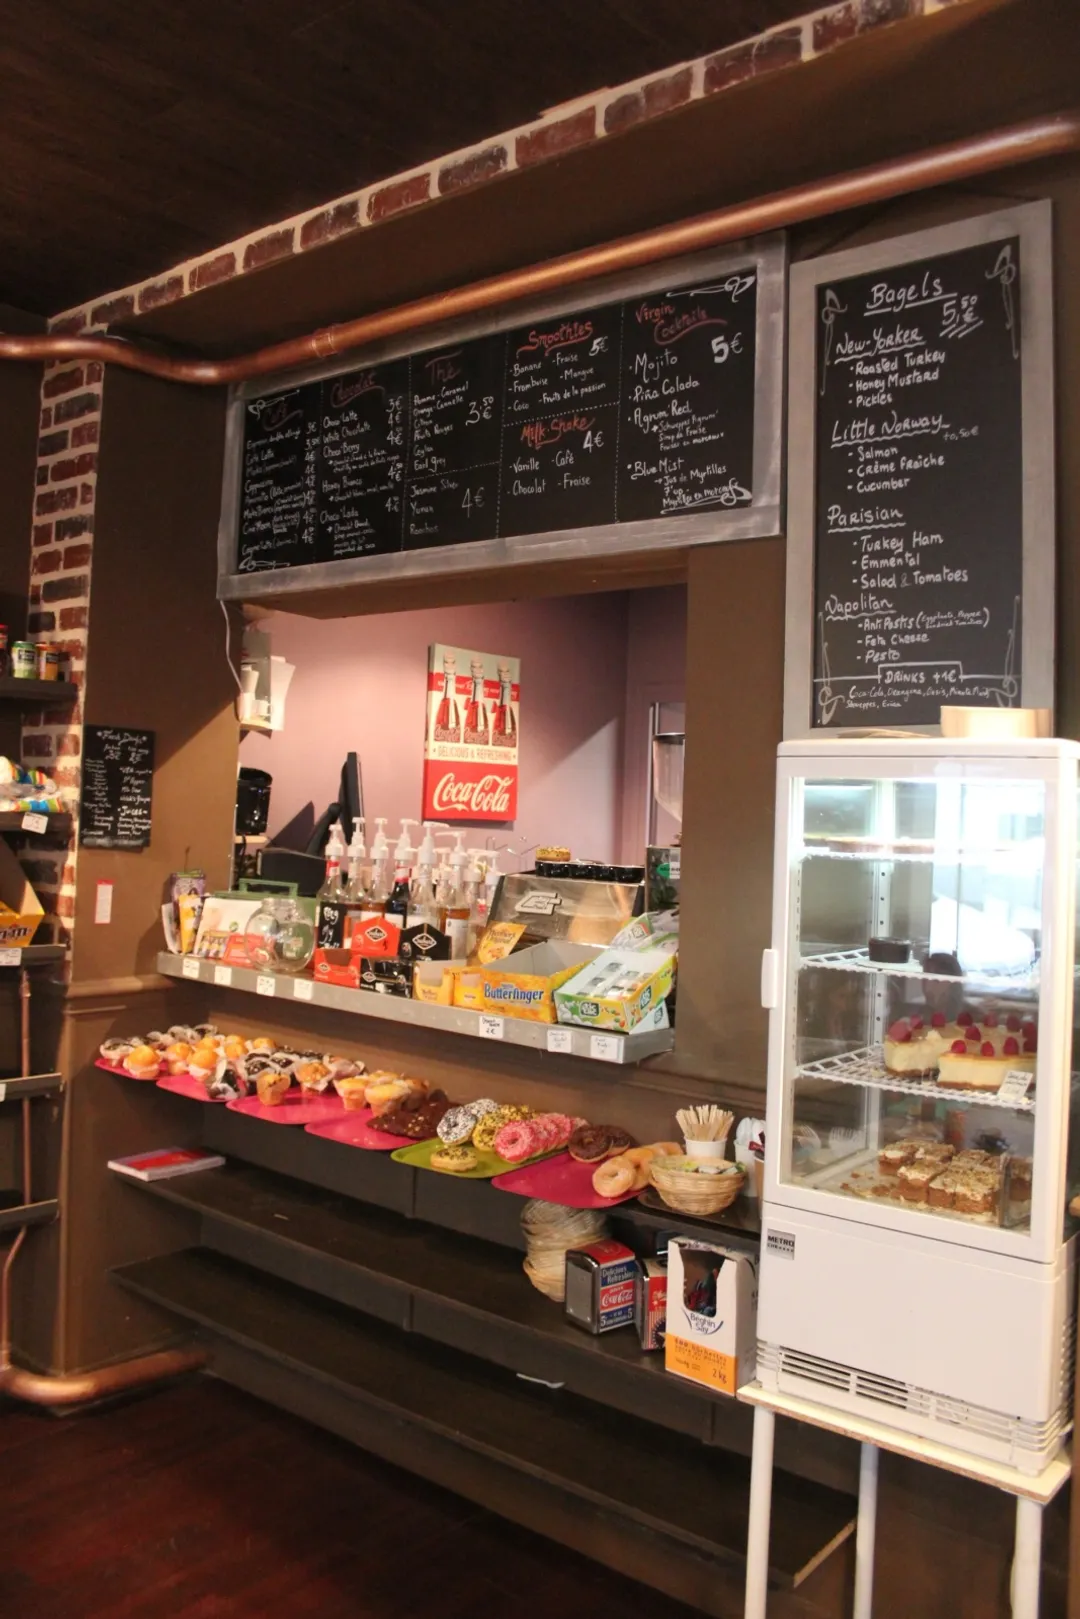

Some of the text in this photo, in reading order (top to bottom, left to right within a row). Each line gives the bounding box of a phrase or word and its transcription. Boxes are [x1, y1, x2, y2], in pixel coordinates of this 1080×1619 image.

[866, 271, 943, 312] Bagels
[635, 302, 676, 323] Virgin
[513, 352, 578, 377] Banane Fraise
[635, 348, 679, 384] Mojito
[855, 350, 946, 376] Roasted Turkey
[513, 367, 594, 393] Framboise Mangue
[633, 375, 700, 403] Piña Colada
[855, 369, 940, 393] Honey Mustard
[513, 382, 606, 412] Coco Fruits de la passion
[855, 394, 893, 408] Pickles
[832, 410, 943, 441] Little Norway
[583, 430, 605, 453] 4€
[413, 458, 429, 471] Earl
[513, 456, 541, 474] Vanille
[858, 446, 898, 461] Salmon
[631, 457, 686, 480] Blue Mist
[513, 473, 593, 496] Chocolat Fraise
[857, 477, 911, 493] Cucumber
[461, 486, 486, 519] 4€
[828, 504, 903, 526] Parisian
[860, 530, 944, 554] Turkey Ham
[861, 552, 920, 570] Emmental
[860, 573, 897, 589] Salad
[912, 565, 969, 586] Tomatoes
[825, 594, 894, 619] Napolitan
[865, 633, 931, 647] Feta Cheese
[865, 648, 901, 663] Pesto
[432, 772, 515, 813] Coca-Cola
[483, 982, 546, 1004] Butterfinger
[602, 1265, 628, 1278] Delicious
[602, 1289, 633, 1307] Coca-Cola
[718, 1370, 727, 1384] kg
